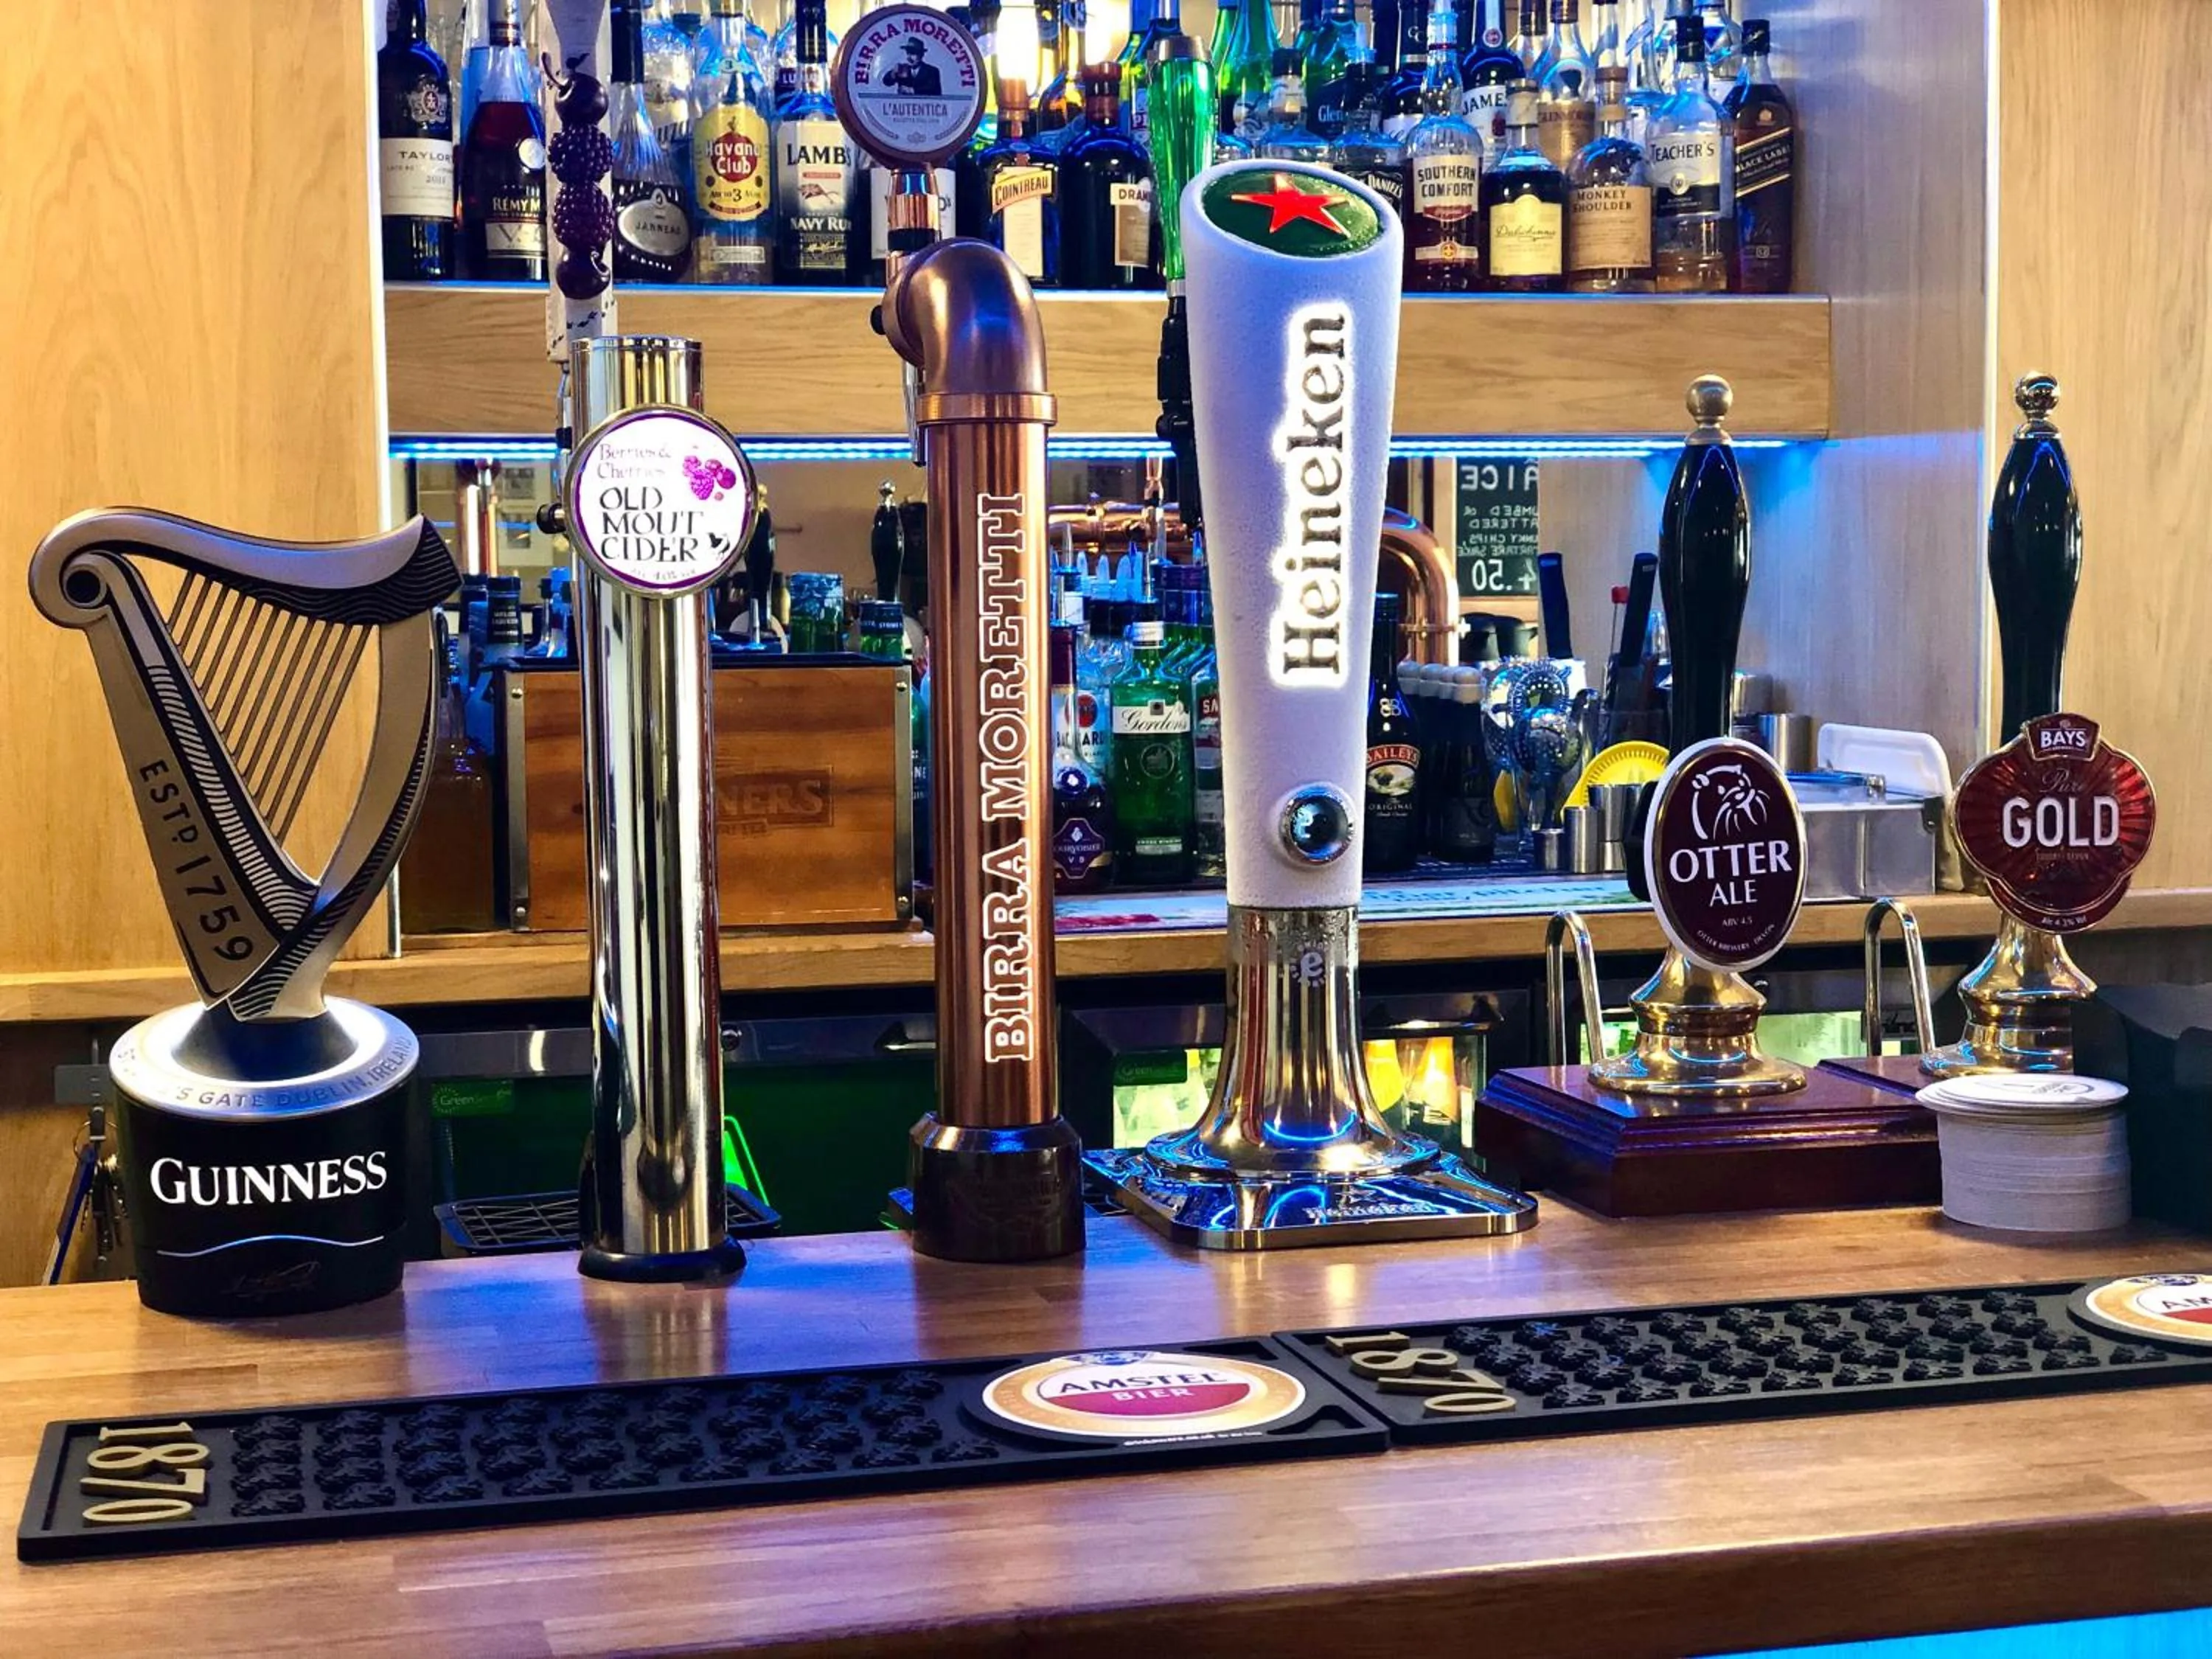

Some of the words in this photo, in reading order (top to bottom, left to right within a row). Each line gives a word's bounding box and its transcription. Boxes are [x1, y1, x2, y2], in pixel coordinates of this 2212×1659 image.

[855, 22, 900, 85] BIRRA
[903, 18, 975, 87] MORETTI
[883, 102, 948, 116] L'AUTENTICA
[1318, 105, 1343, 122] Glen
[1463, 93, 1507, 115] JAME
[399, 150, 451, 163] TAYLOR
[1650, 142, 1714, 161] TEACHER'S
[716, 156, 752, 174] Club
[1418, 164, 1477, 182] SOUTHERN
[733, 188, 742, 203] 3
[995, 175, 1048, 205] COINTREAU
[1422, 184, 1474, 198] COMFORT
[1576, 190, 1627, 201] MONKEY
[1573, 201, 1632, 213] SHOULDER
[599, 487, 663, 510] OLD
[1283, 313, 1345, 675] Heineken
[602, 511, 704, 535] MOUT
[601, 537, 698, 562] CIDER
[977, 493, 1031, 822] MORETTI
[2040, 731, 2086, 748] BAYS
[2002, 796, 2120, 848] GOLD
[1669, 840, 1793, 883] OTTER
[1709, 880, 1758, 907] ALE
[176, 855, 255, 961] 1759
[981, 837, 1033, 1062] BIRRA
[369, 1036, 413, 1086] IRELAND
[150, 1151, 387, 1206] GUINNESS
[1060, 1372, 1227, 1394] AMSTEL
[1111, 1387, 1193, 1402] BIER
[80, 1422, 211, 1524] 1870
